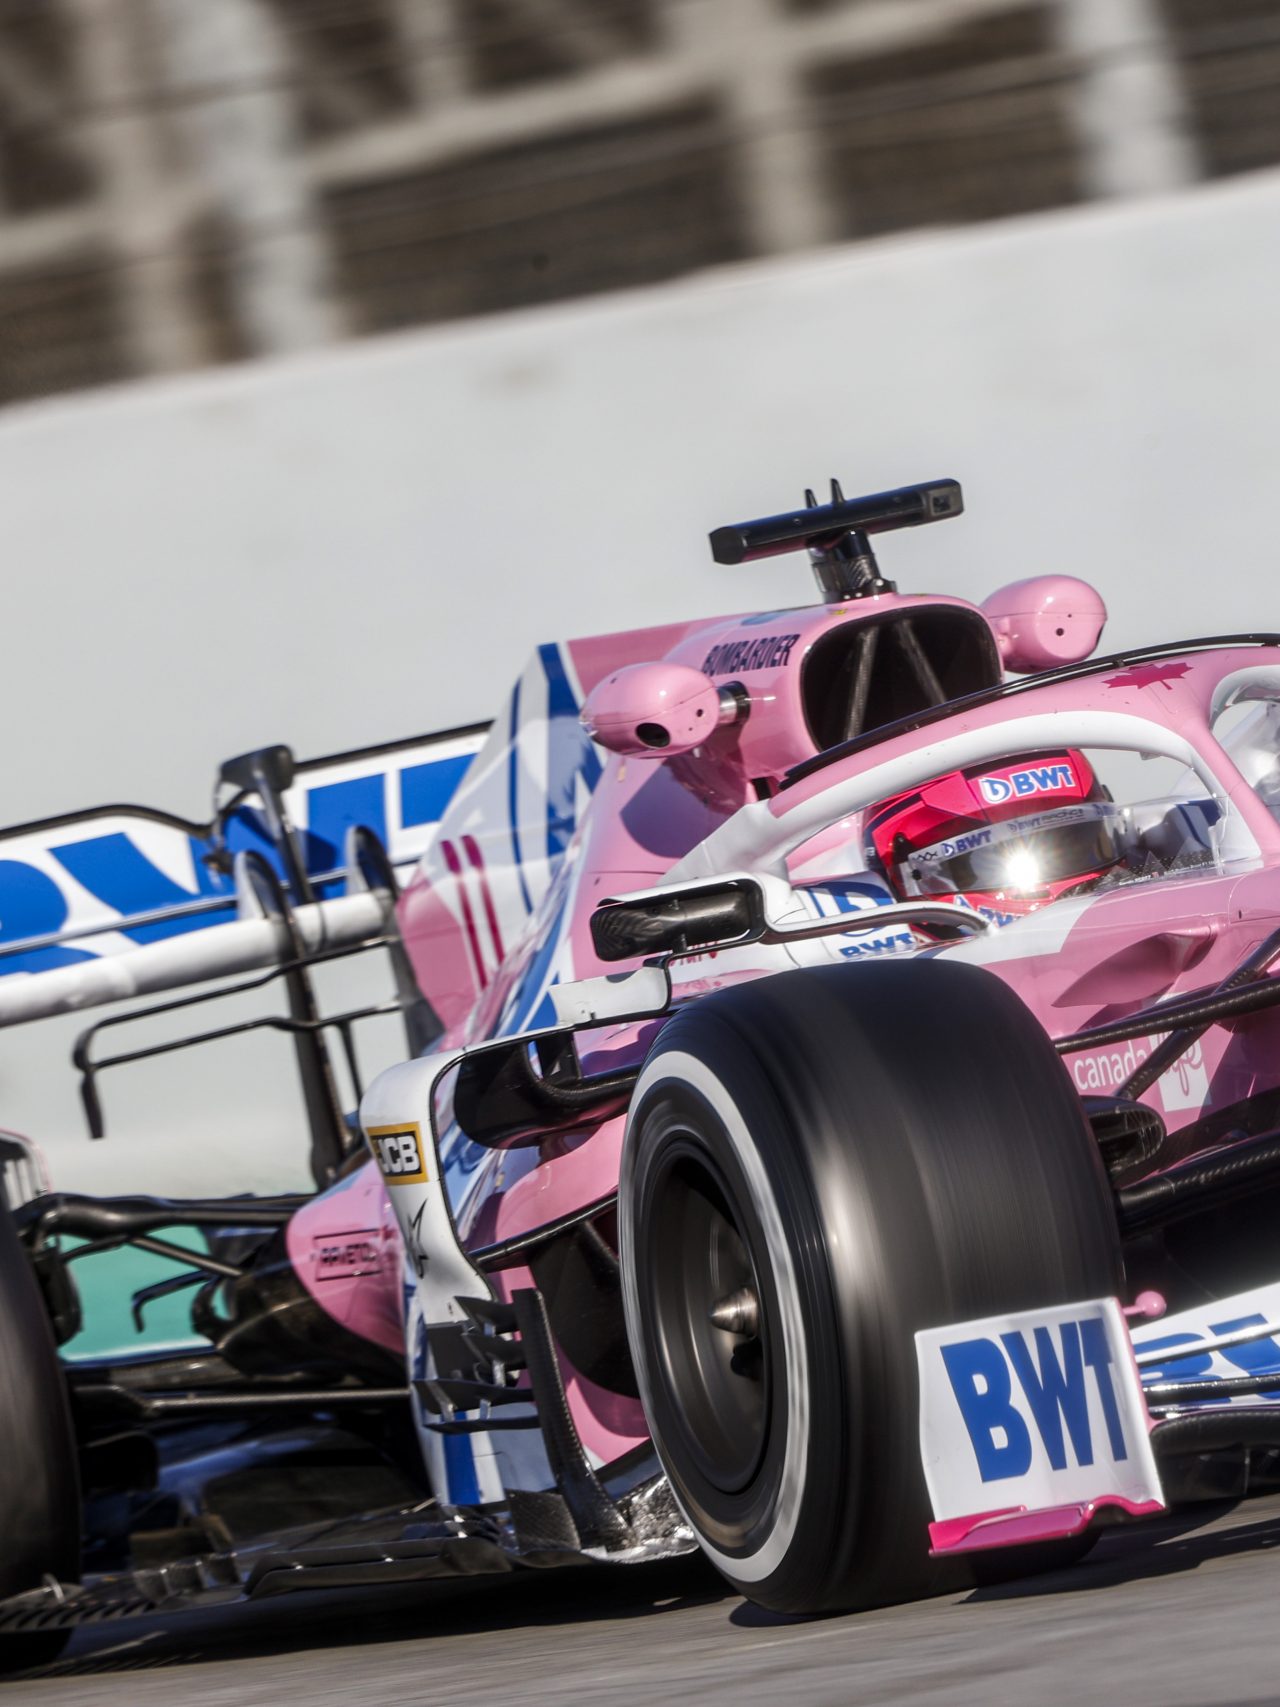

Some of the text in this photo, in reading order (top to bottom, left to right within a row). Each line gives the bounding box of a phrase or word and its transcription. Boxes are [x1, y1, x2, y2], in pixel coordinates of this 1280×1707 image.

[1012, 765, 1073, 796] BWT
[957, 830, 993, 851] BWT
[839, 933, 914, 959] BWT
[939, 1317, 1128, 1483] BWT
